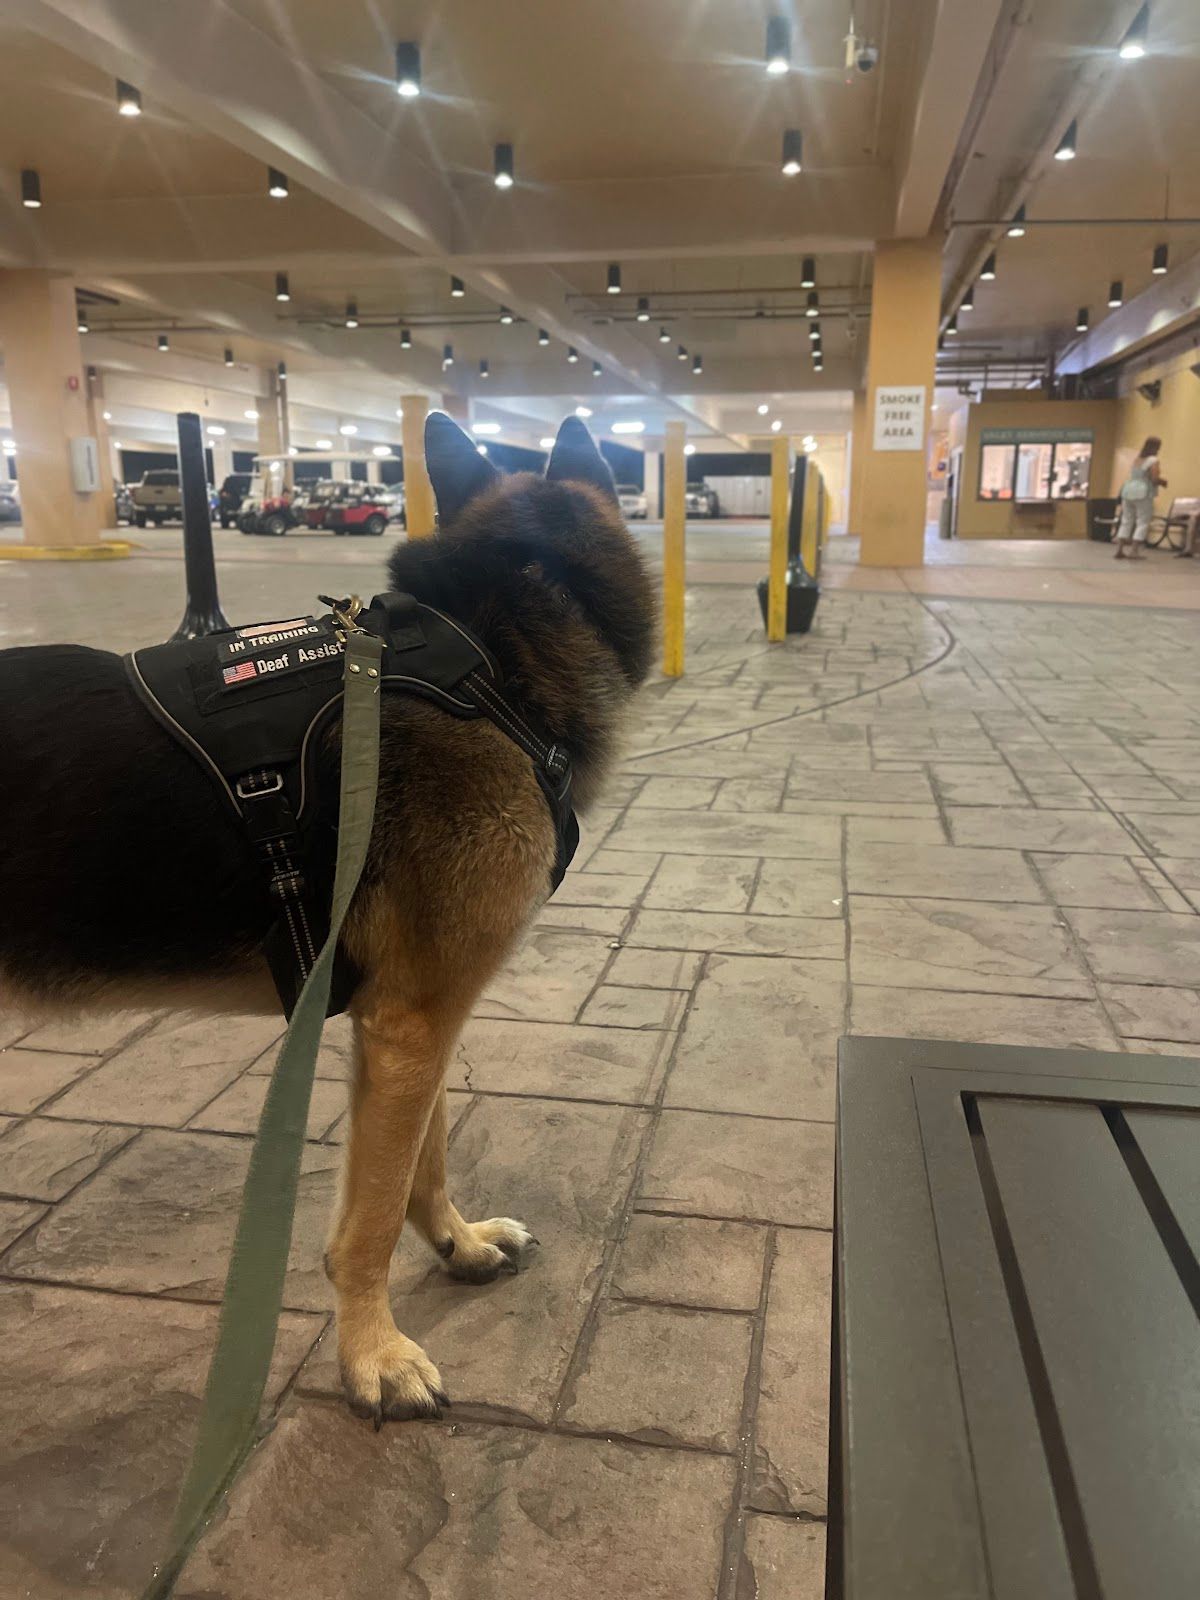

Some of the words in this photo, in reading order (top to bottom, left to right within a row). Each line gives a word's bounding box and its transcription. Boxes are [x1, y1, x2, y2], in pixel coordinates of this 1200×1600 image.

[879, 394, 920, 405] SMOKE
[884, 411, 911, 421] FREE
[883, 427, 914, 437] AREA
[229, 641, 246, 653] IN
[249, 625, 319, 647] TRAINING
[256, 653, 290, 674] Deaf
[298, 640, 346, 663] Assist
